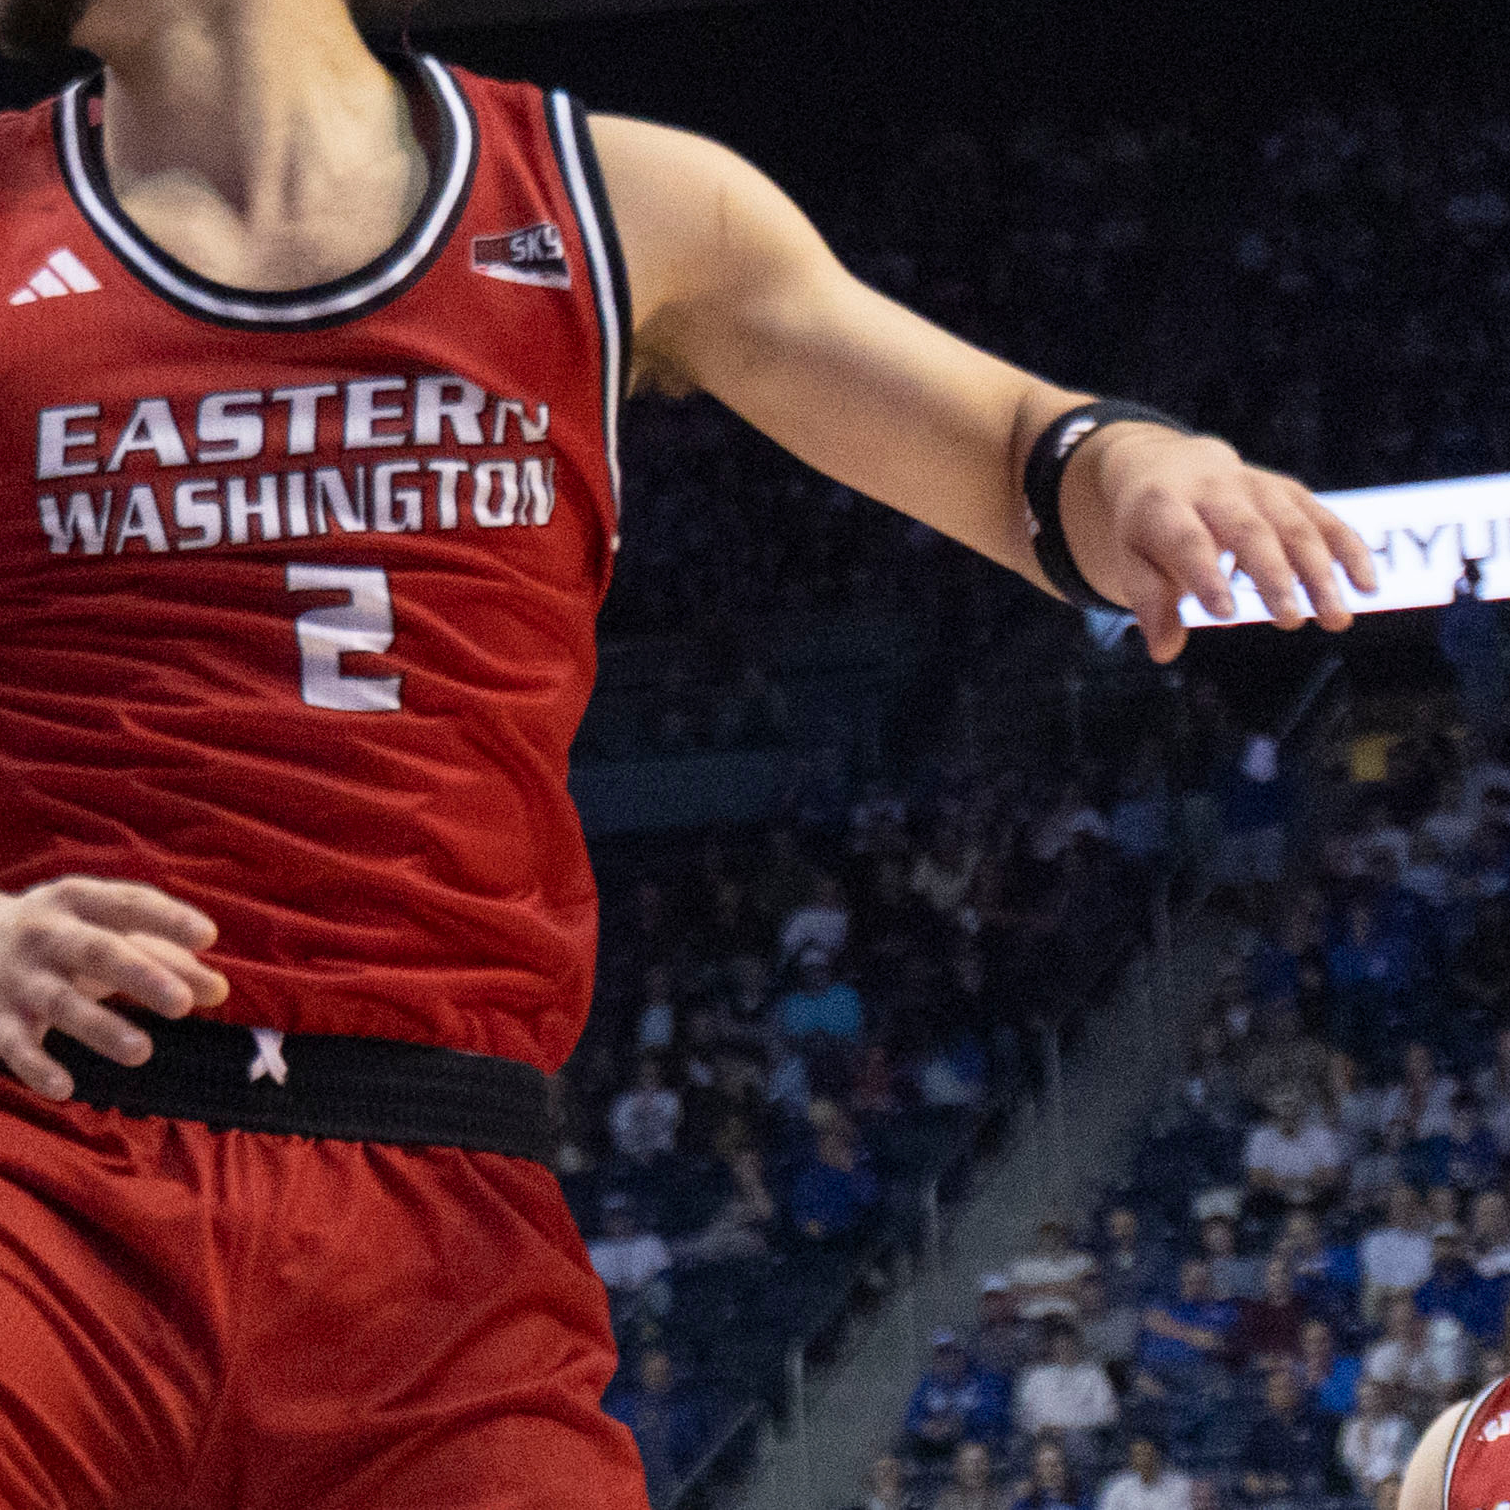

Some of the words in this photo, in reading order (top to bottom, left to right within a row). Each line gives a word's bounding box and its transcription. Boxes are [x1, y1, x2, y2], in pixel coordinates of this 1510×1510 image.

[36, 375, 550, 480] EASTERN
[36, 456, 557, 556] WASHINGTON
[285, 561, 402, 712] 2
